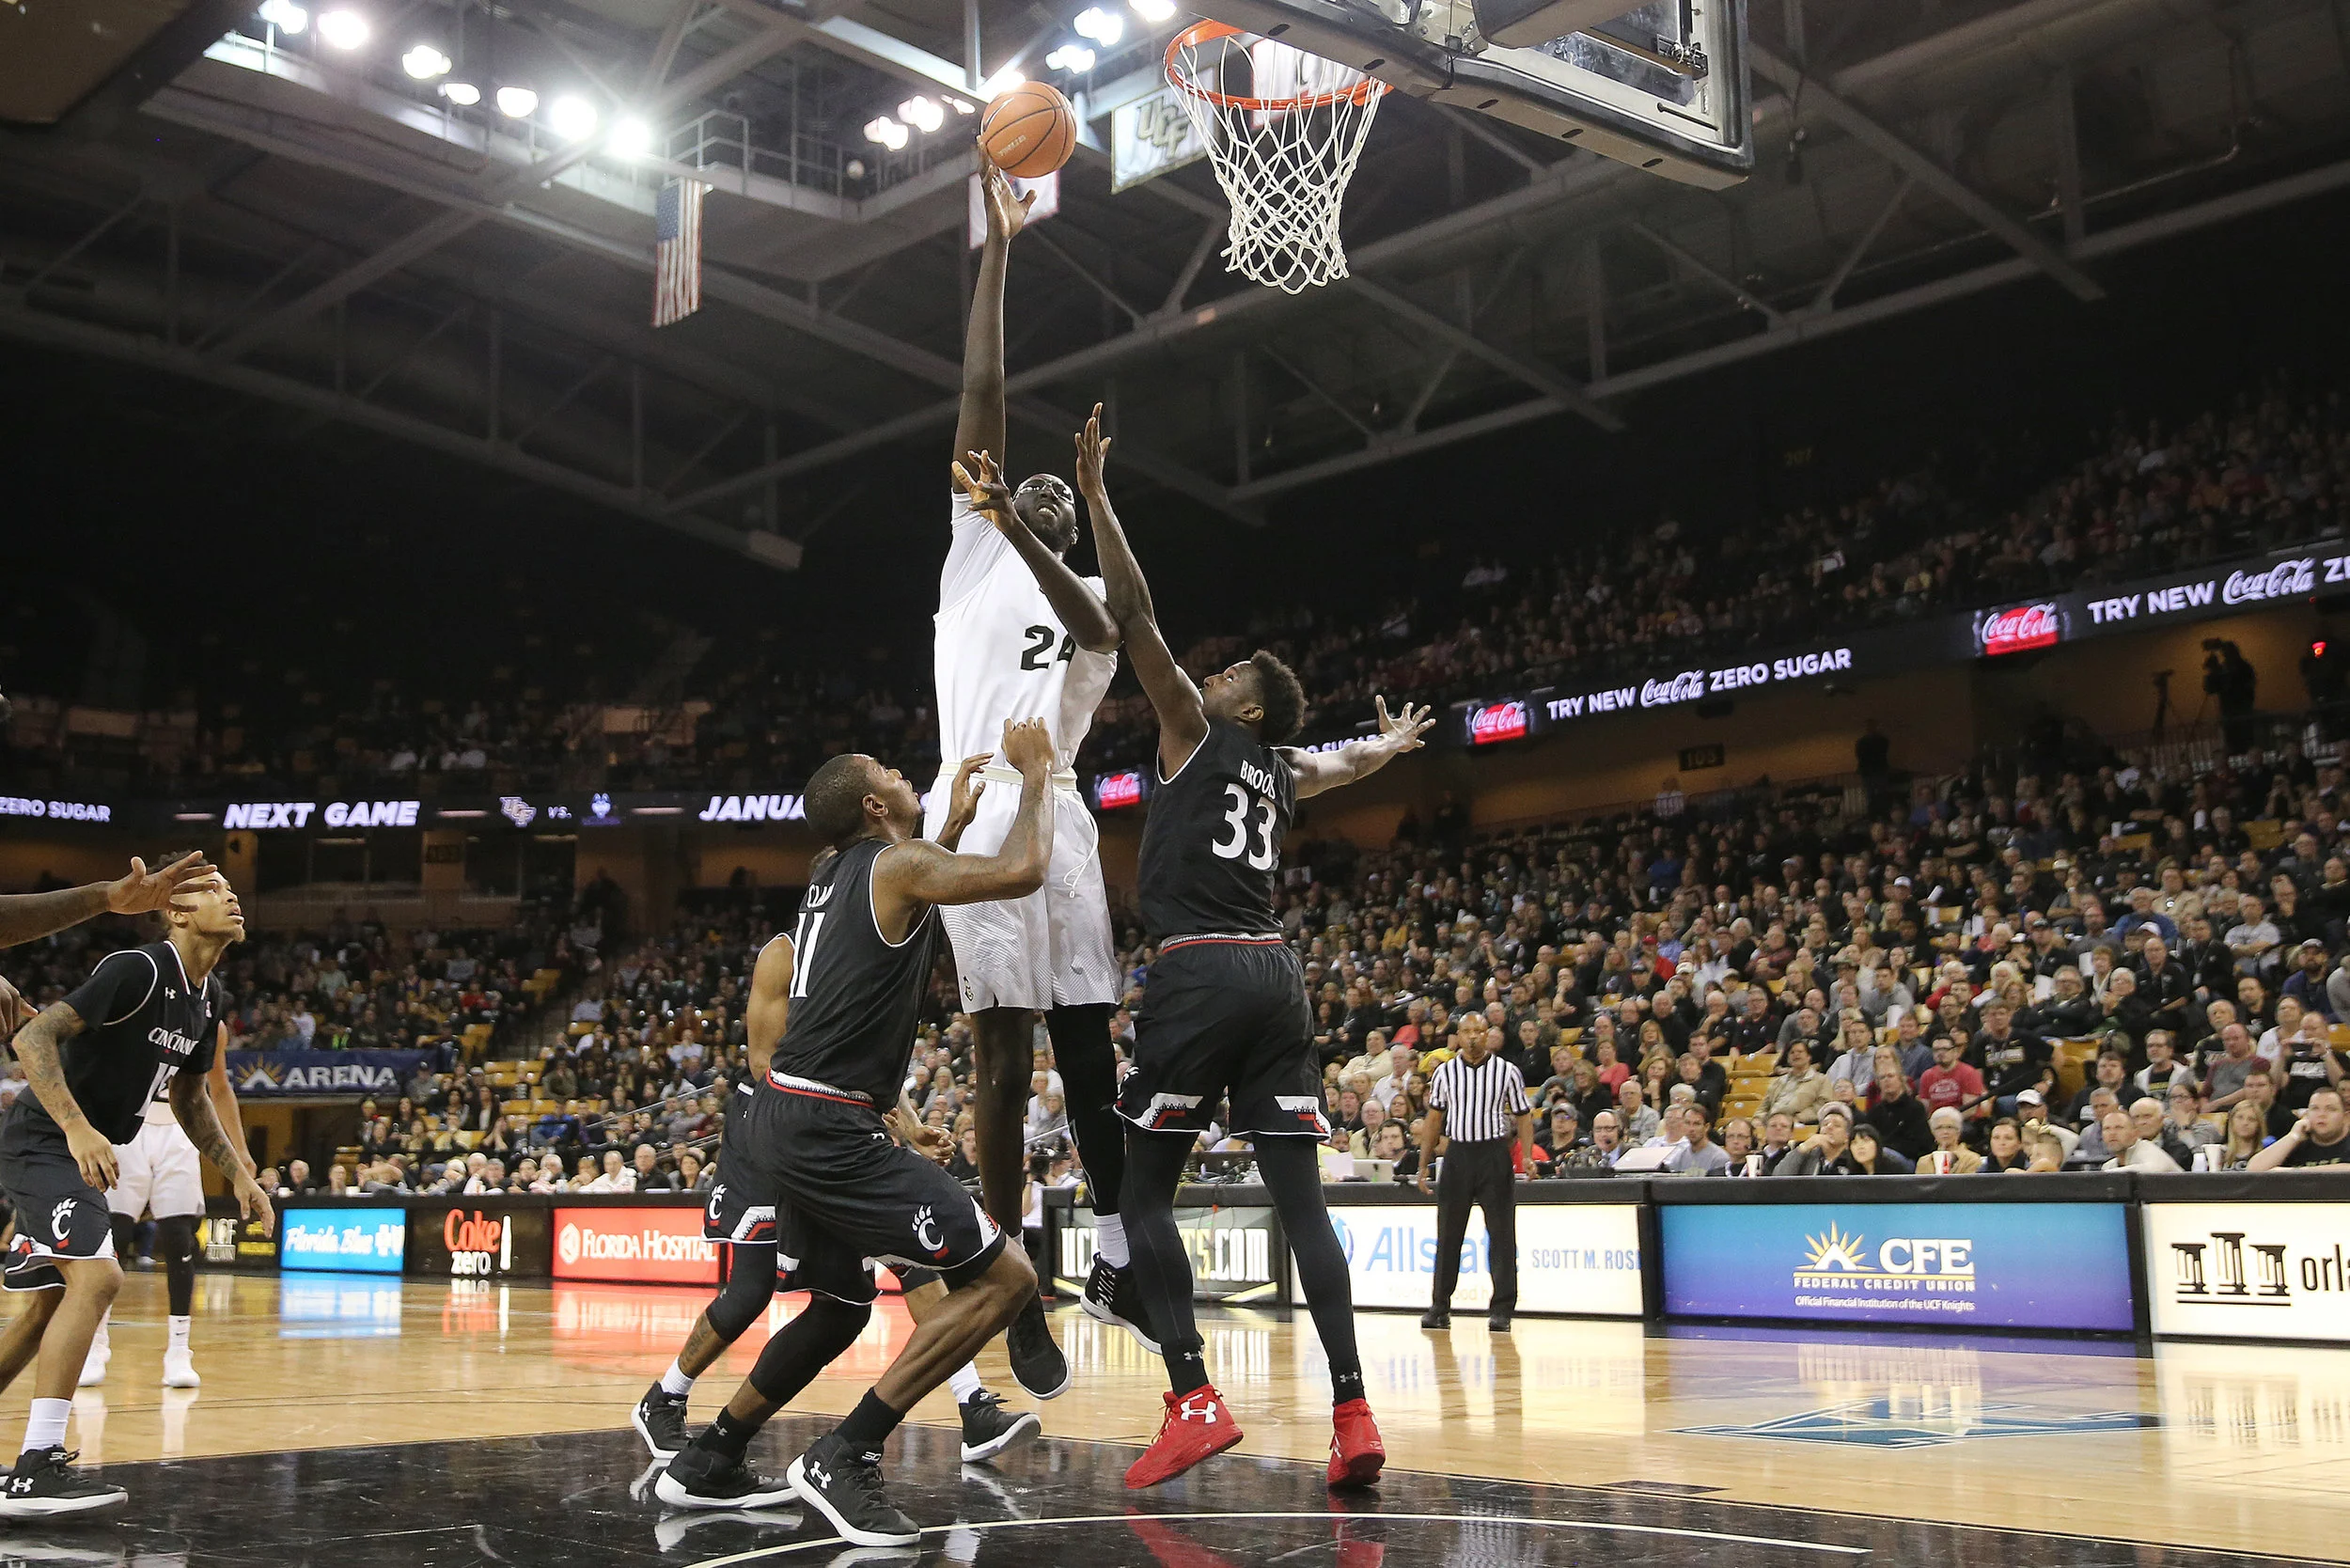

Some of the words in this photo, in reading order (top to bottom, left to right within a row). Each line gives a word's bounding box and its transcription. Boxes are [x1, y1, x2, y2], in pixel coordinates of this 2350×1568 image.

[2087, 594, 2141, 624] TRY
[2147, 580, 2216, 614] NEW
[1020, 624, 1077, 671] 24
[1546, 696, 1585, 721] TRY
[1589, 685, 1637, 713] NEW
[1709, 663, 1769, 692] ZERO
[1774, 648, 1853, 681] SUGAR
[0, 796, 46, 817] ZERO
[48, 800, 111, 823] SUGAR
[223, 802, 316, 829] NEXT
[324, 800, 420, 827] GAME
[698, 794, 807, 822] JANUA
[1212, 782, 1277, 870] 33
[789, 912, 826, 998] 11
[283, 1064, 398, 1088] ARENA
[284, 1225, 338, 1254] Florida
[339, 1225, 374, 1255] Blue
[444, 1208, 501, 1253] Coke
[582, 1229, 643, 1259] FLORIDA
[643, 1230, 718, 1262] HOSPITAL
[1532, 1248, 1579, 1269] SCOTT
[1584, 1249, 1601, 1270] M.
[1879, 1237, 1975, 1274] CFE
[2301, 1244, 2350, 1292] orl
[1794, 1277, 1858, 1290] FEDERAL
[1863, 1278, 1919, 1291] CREDIT
[1925, 1280, 1976, 1293] UNION
[1794, 1295, 1823, 1307] Official
[1824, 1295, 1857, 1308] Financial
[1857, 1296, 1899, 1309] Institution
[1899, 1297, 1909, 1309] of
[1909, 1297, 1923, 1309] the
[1941, 1299, 1976, 1313] Knights
